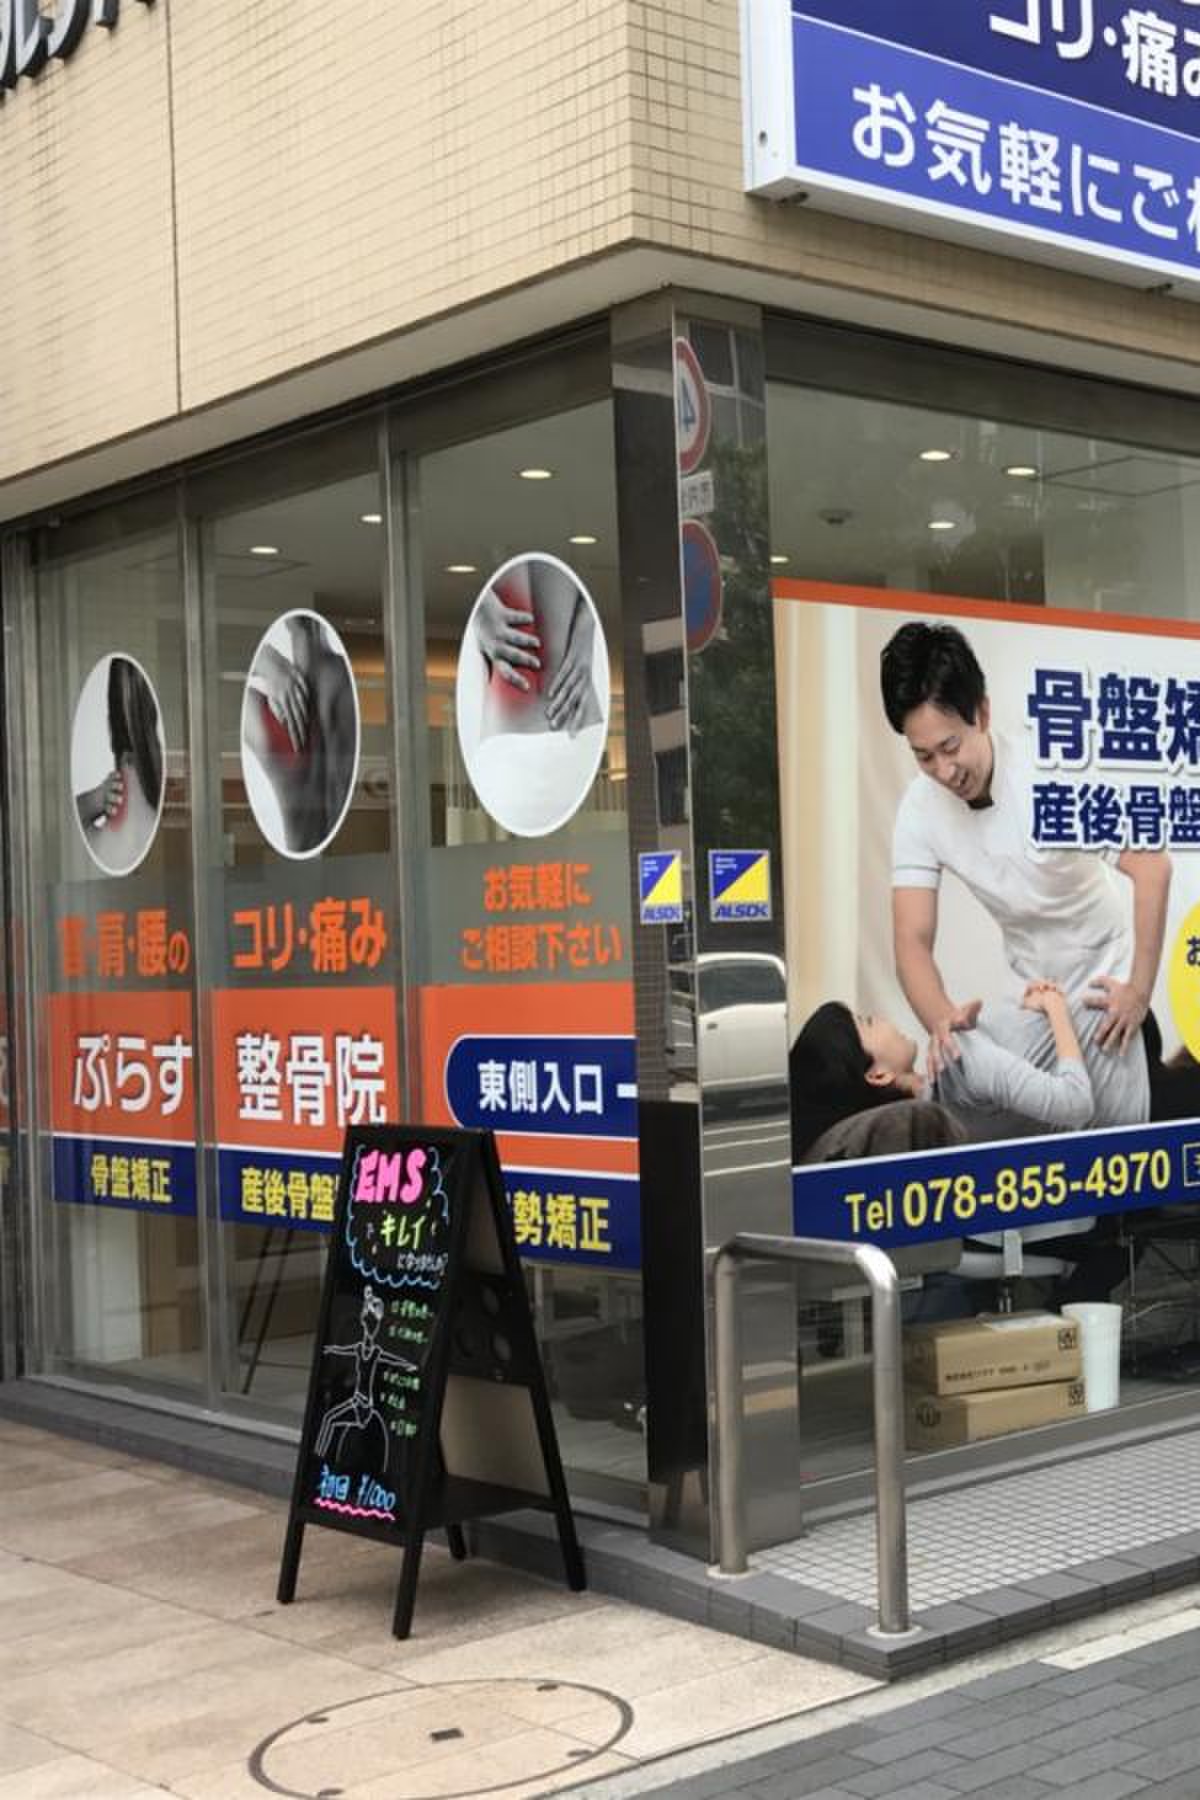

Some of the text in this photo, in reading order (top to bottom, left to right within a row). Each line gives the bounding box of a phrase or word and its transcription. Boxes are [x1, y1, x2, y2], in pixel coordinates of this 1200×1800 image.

[484, 864, 592, 913] お気軽に
[232, 896, 389, 974] コリ・痛み
[462, 920, 623, 973] ご相談下さい
[73, 1034, 193, 1116] ぷらす
[235, 1033, 388, 1129] 整骨院
[477, 1059, 604, 1115] 東側入口
[90, 1154, 172, 1203] 骨盤矯正
[241, 1166, 340, 1222] 産後骨盤
[355, 1148, 427, 1204] EMS
[845, 1149, 1171, 1233] Tel 078-855-4970
[506, 1190, 612, 1252] 勢矯正
